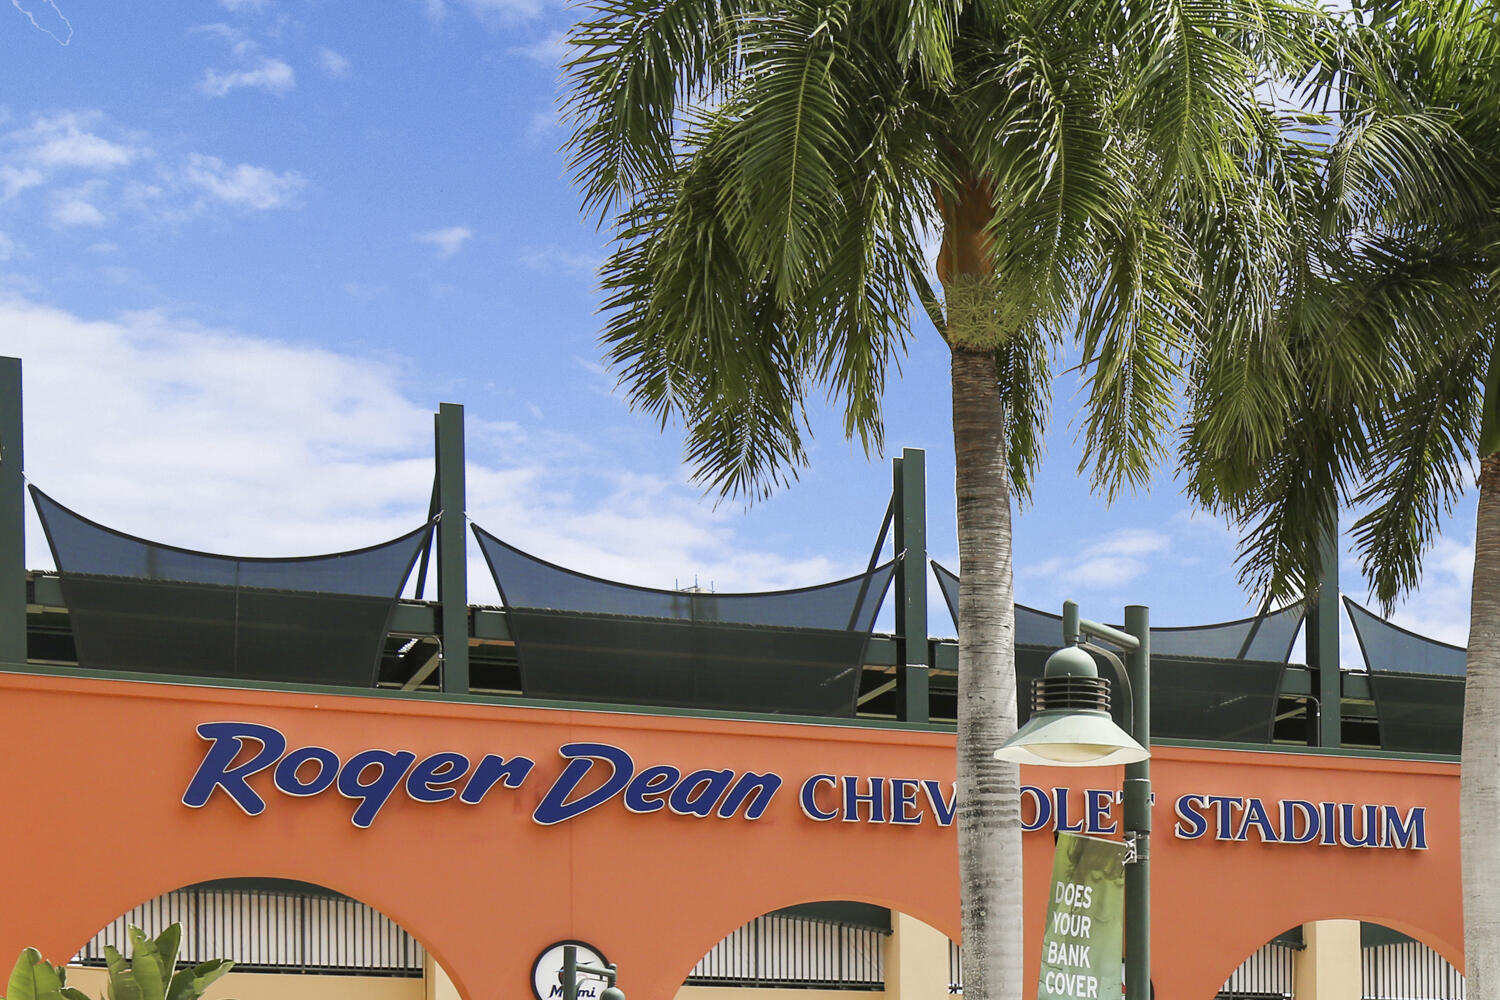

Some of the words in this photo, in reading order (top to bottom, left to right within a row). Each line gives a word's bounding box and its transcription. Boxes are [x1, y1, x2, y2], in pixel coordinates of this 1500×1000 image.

[182, 721, 535, 829] Roger
[531, 742, 783, 826] Dean
[800, 774, 1155, 835] CHEVOLE
[1174, 793, 1429, 850] STADIUM
[1055, 881, 1093, 909] DOES
[1052, 911, 1092, 939] YOUR
[1047, 943, 1091, 969] BANK
[548, 984, 596, 998] Mmi
[1045, 971, 1098, 999] COVER
